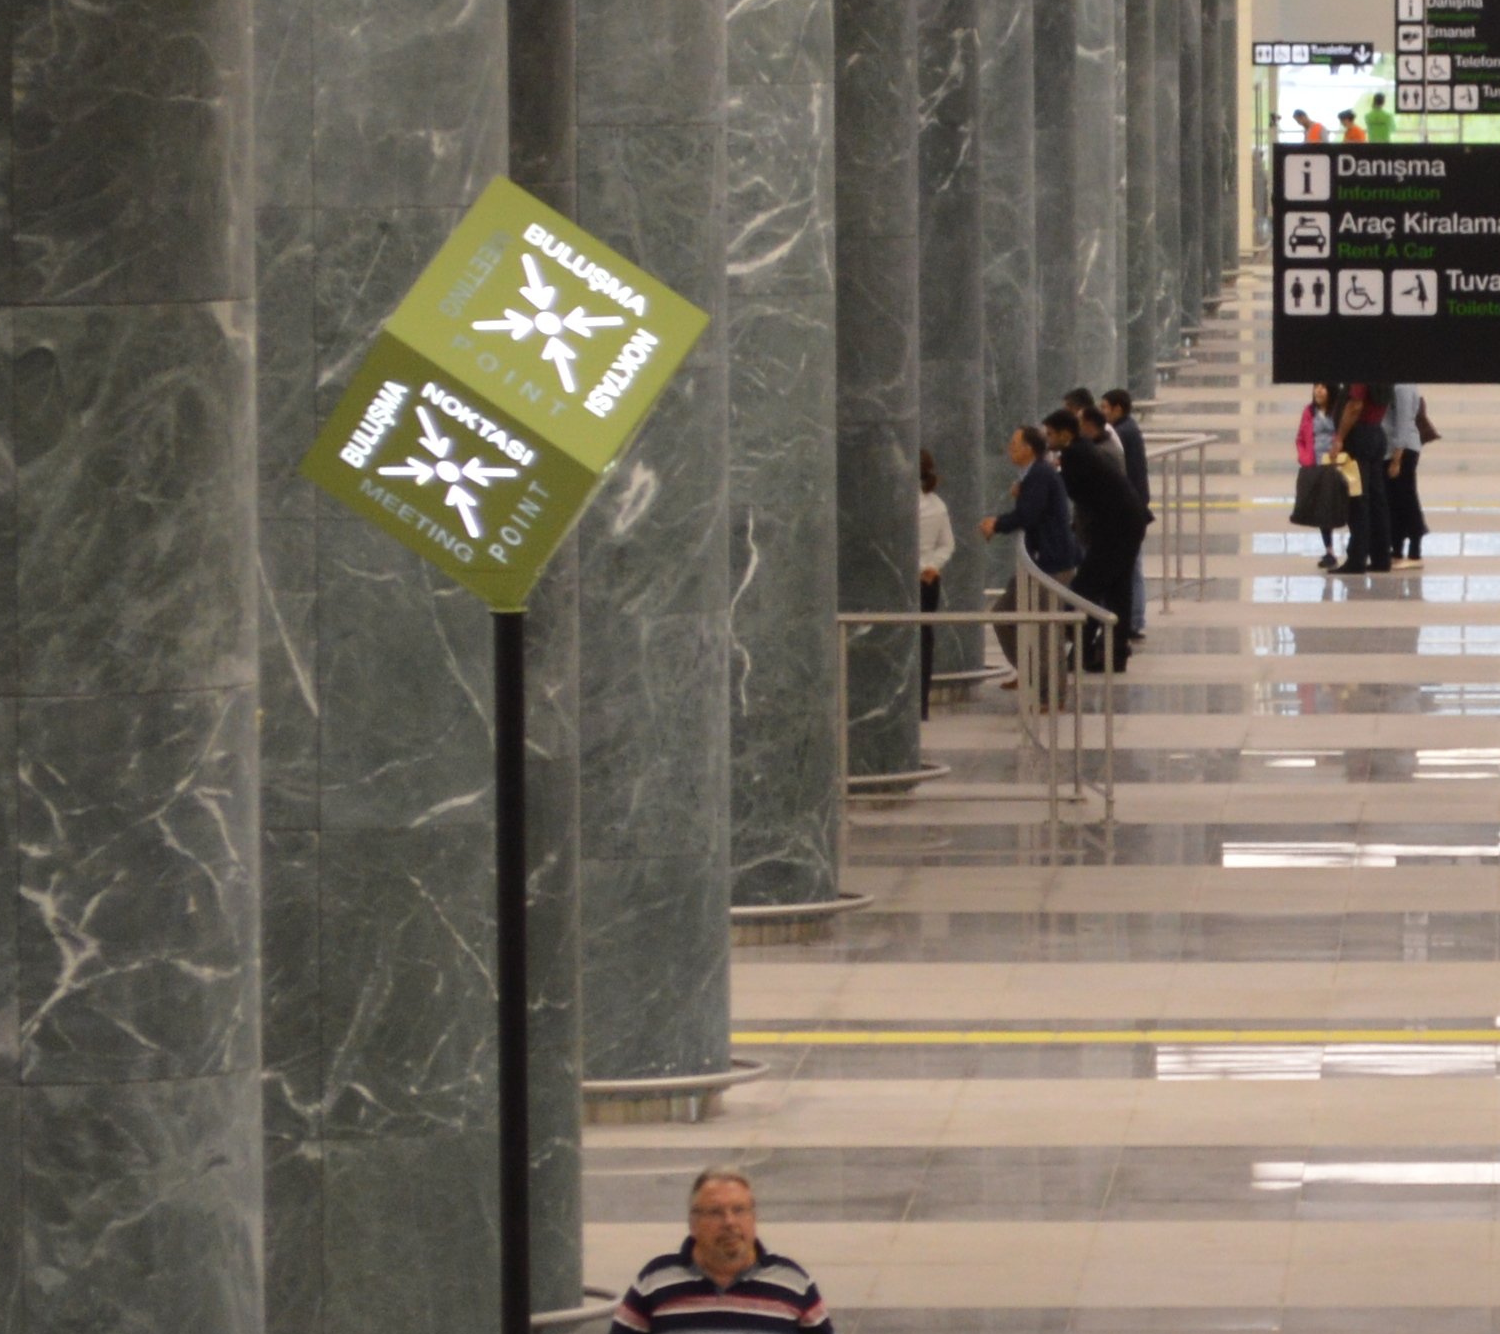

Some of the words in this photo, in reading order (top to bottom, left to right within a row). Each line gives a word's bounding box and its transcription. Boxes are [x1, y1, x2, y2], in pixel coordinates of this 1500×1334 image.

[1427, 26, 1476, 38] Emanet
[1337, 155, 1446, 180] Danışma
[1337, 186, 1441, 201] Information
[1337, 243, 1380, 258] Rent
[1385, 243, 1399, 258] A
[1404, 243, 1435, 258] Car
[1338, 213, 1396, 238] Araç
[522, 222, 646, 317] BULUŞMA
[452, 334, 568, 415] POINT
[583, 327, 659, 418] NOKTASI
[339, 380, 409, 468] BULUŞMA
[421, 382, 535, 466] NOKTASI
[359, 478, 475, 563] MEETING
[488, 480, 549, 564] POINT
